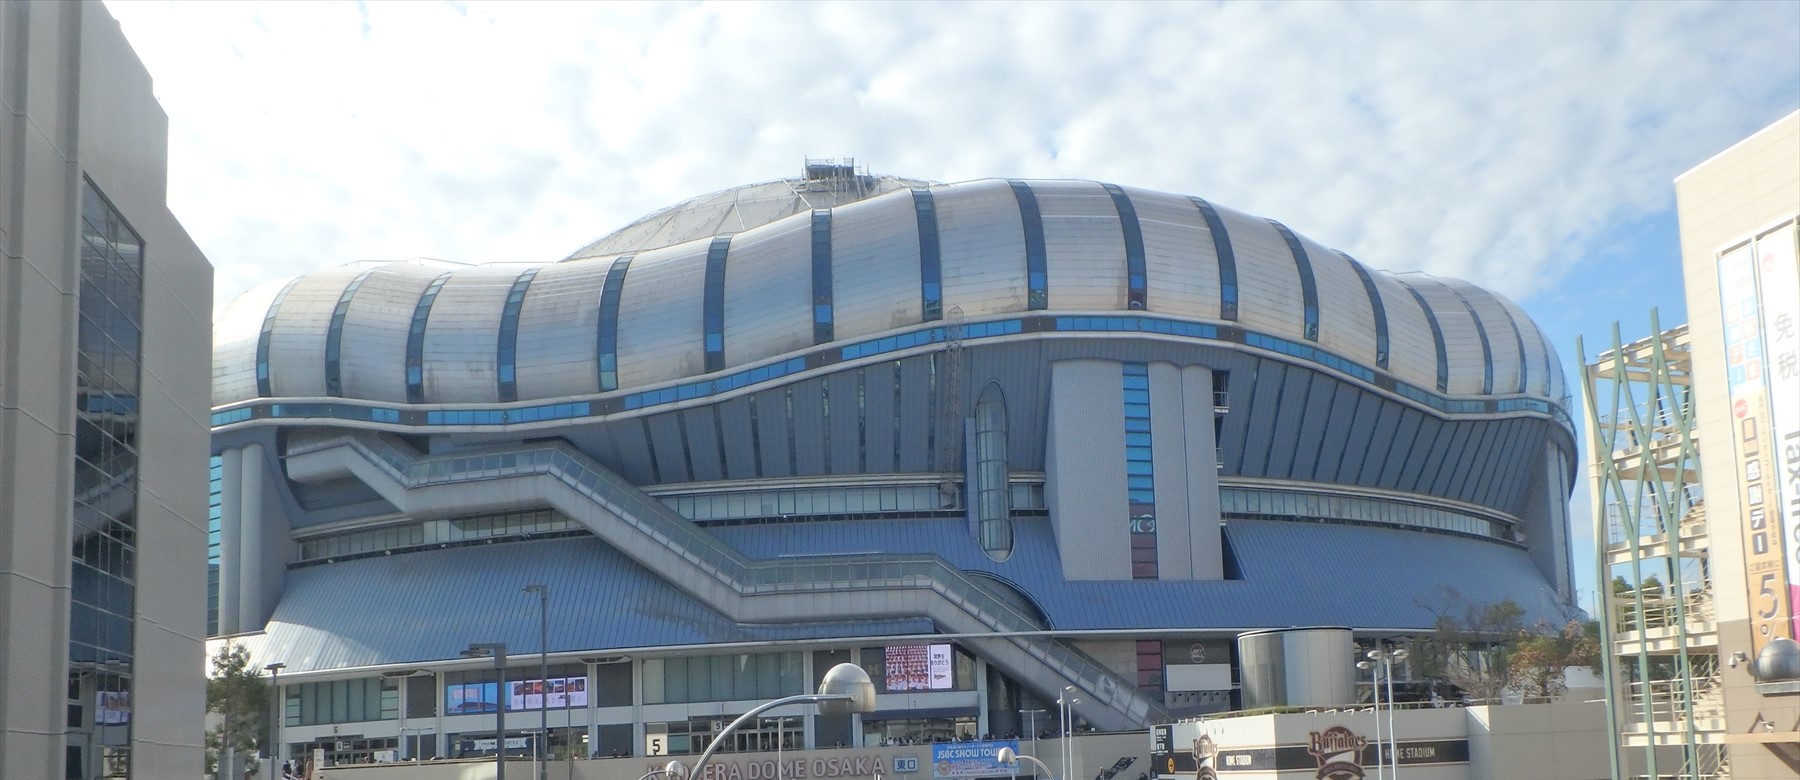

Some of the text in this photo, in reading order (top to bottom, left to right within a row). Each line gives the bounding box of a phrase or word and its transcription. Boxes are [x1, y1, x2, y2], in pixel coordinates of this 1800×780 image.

[1774, 312, 1799, 381] 免税
[652, 739, 661, 753] 5
[1309, 731, 1367, 753] Buffaloes
[937, 747, 999, 759] JSBC SNOW TOW
[1406, 747, 1435, 759] STADIUM
[647, 756, 886, 780] KOERA DOME OSAKA
[897, 759, 916, 770] 東口
